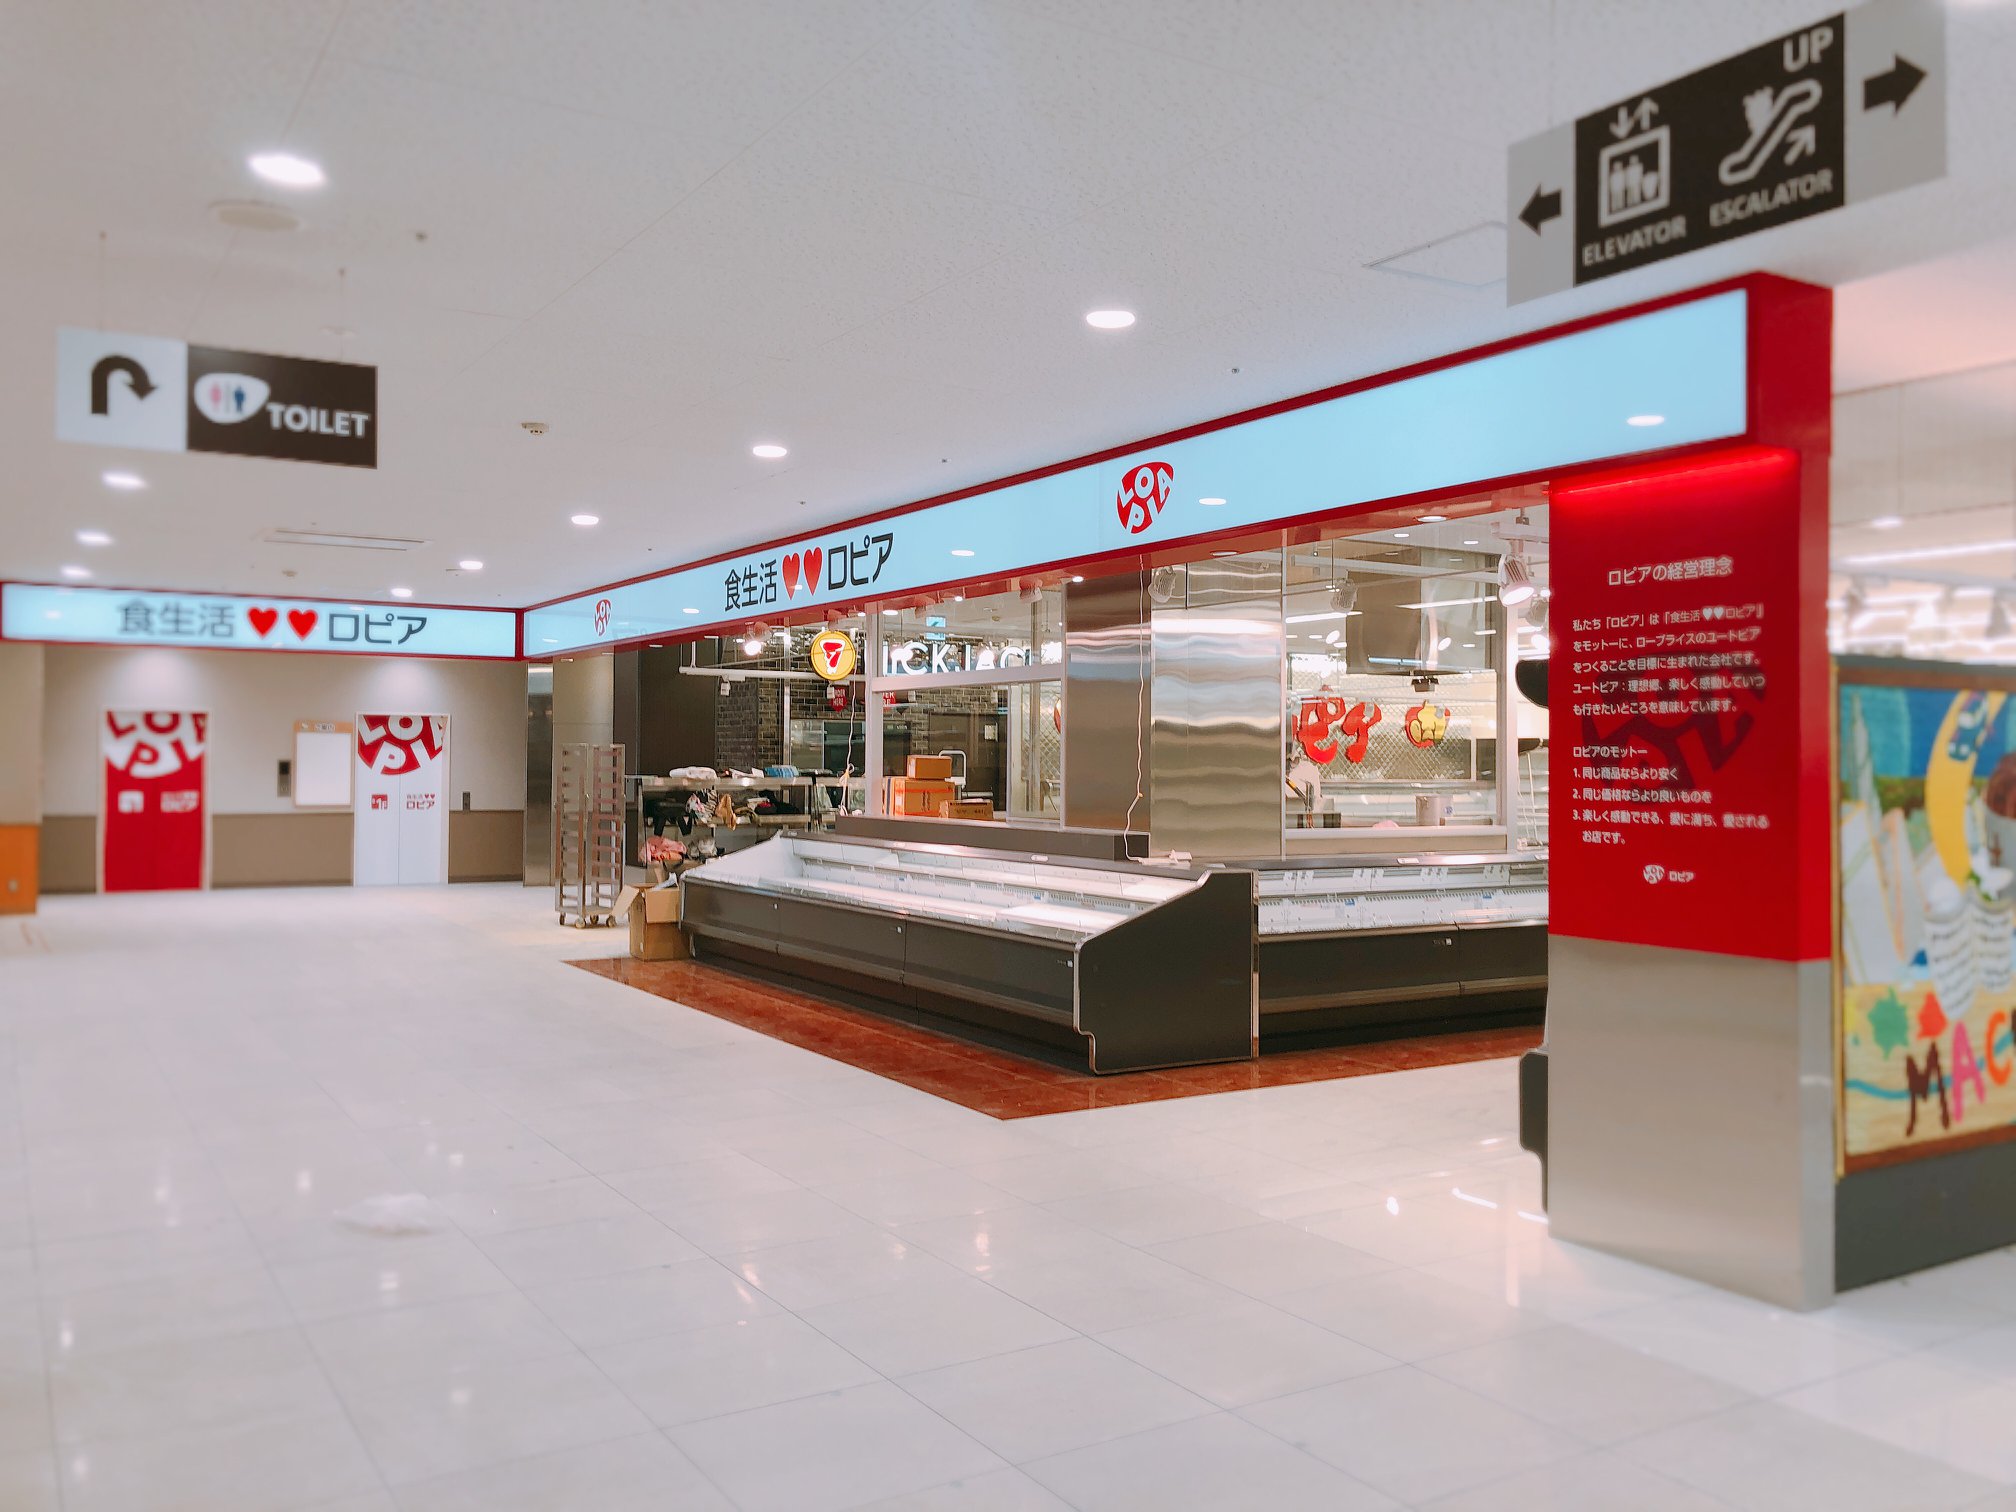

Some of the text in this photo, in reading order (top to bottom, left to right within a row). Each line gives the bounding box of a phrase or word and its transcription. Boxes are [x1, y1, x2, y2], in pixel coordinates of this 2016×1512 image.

[1782, 26, 1834, 72] UP
[1709, 168, 1833, 227] ESCALATOR
[1582, 215, 1687, 267] ELEVATOR
[265, 402, 371, 438] TOILET
[724, 532, 893, 612] 食生活 ロピア
[1608, 556, 1734, 586] ロピアの経営理念
[117, 598, 428, 645] 食生活 ロピア
[1572, 746, 1648, 758] ロピアのモットー
[1905, 1008, 2016, 1138] MAC
